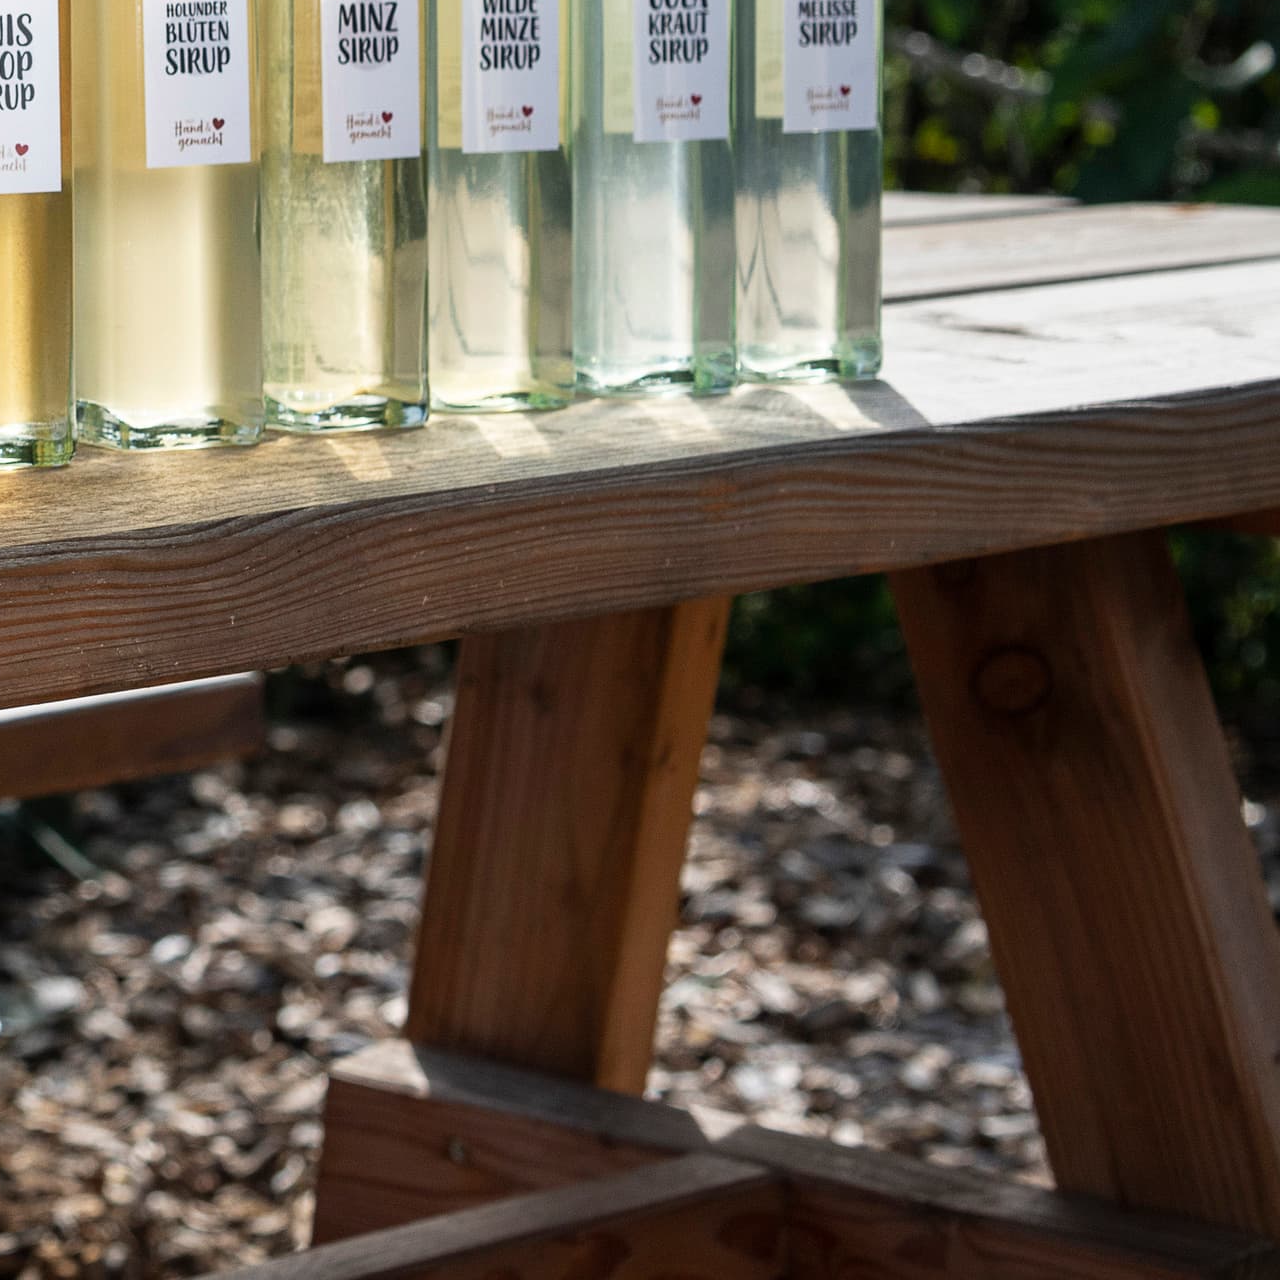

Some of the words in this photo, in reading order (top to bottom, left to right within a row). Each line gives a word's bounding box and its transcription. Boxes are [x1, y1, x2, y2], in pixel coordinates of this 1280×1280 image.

[165, 0, 229, 18] HOLUNDER
[338, 1, 399, 34] MINZ
[798, 0, 857, 19] MELISSE
[165, 18, 230, 44] BLÜTEN
[480, 16, 541, 42] MINZE
[648, 11, 709, 36] KRAUT
[798, 21, 858, 47] SIRUP
[165, 46, 231, 75] SIRUP
[337, 35, 399, 65] SIRUP
[479, 42, 541, 71] SIRUP
[648, 38, 709, 65] SIRUP
[174, 117, 206, 137] Hand
[177, 131, 224, 151] gemacht
